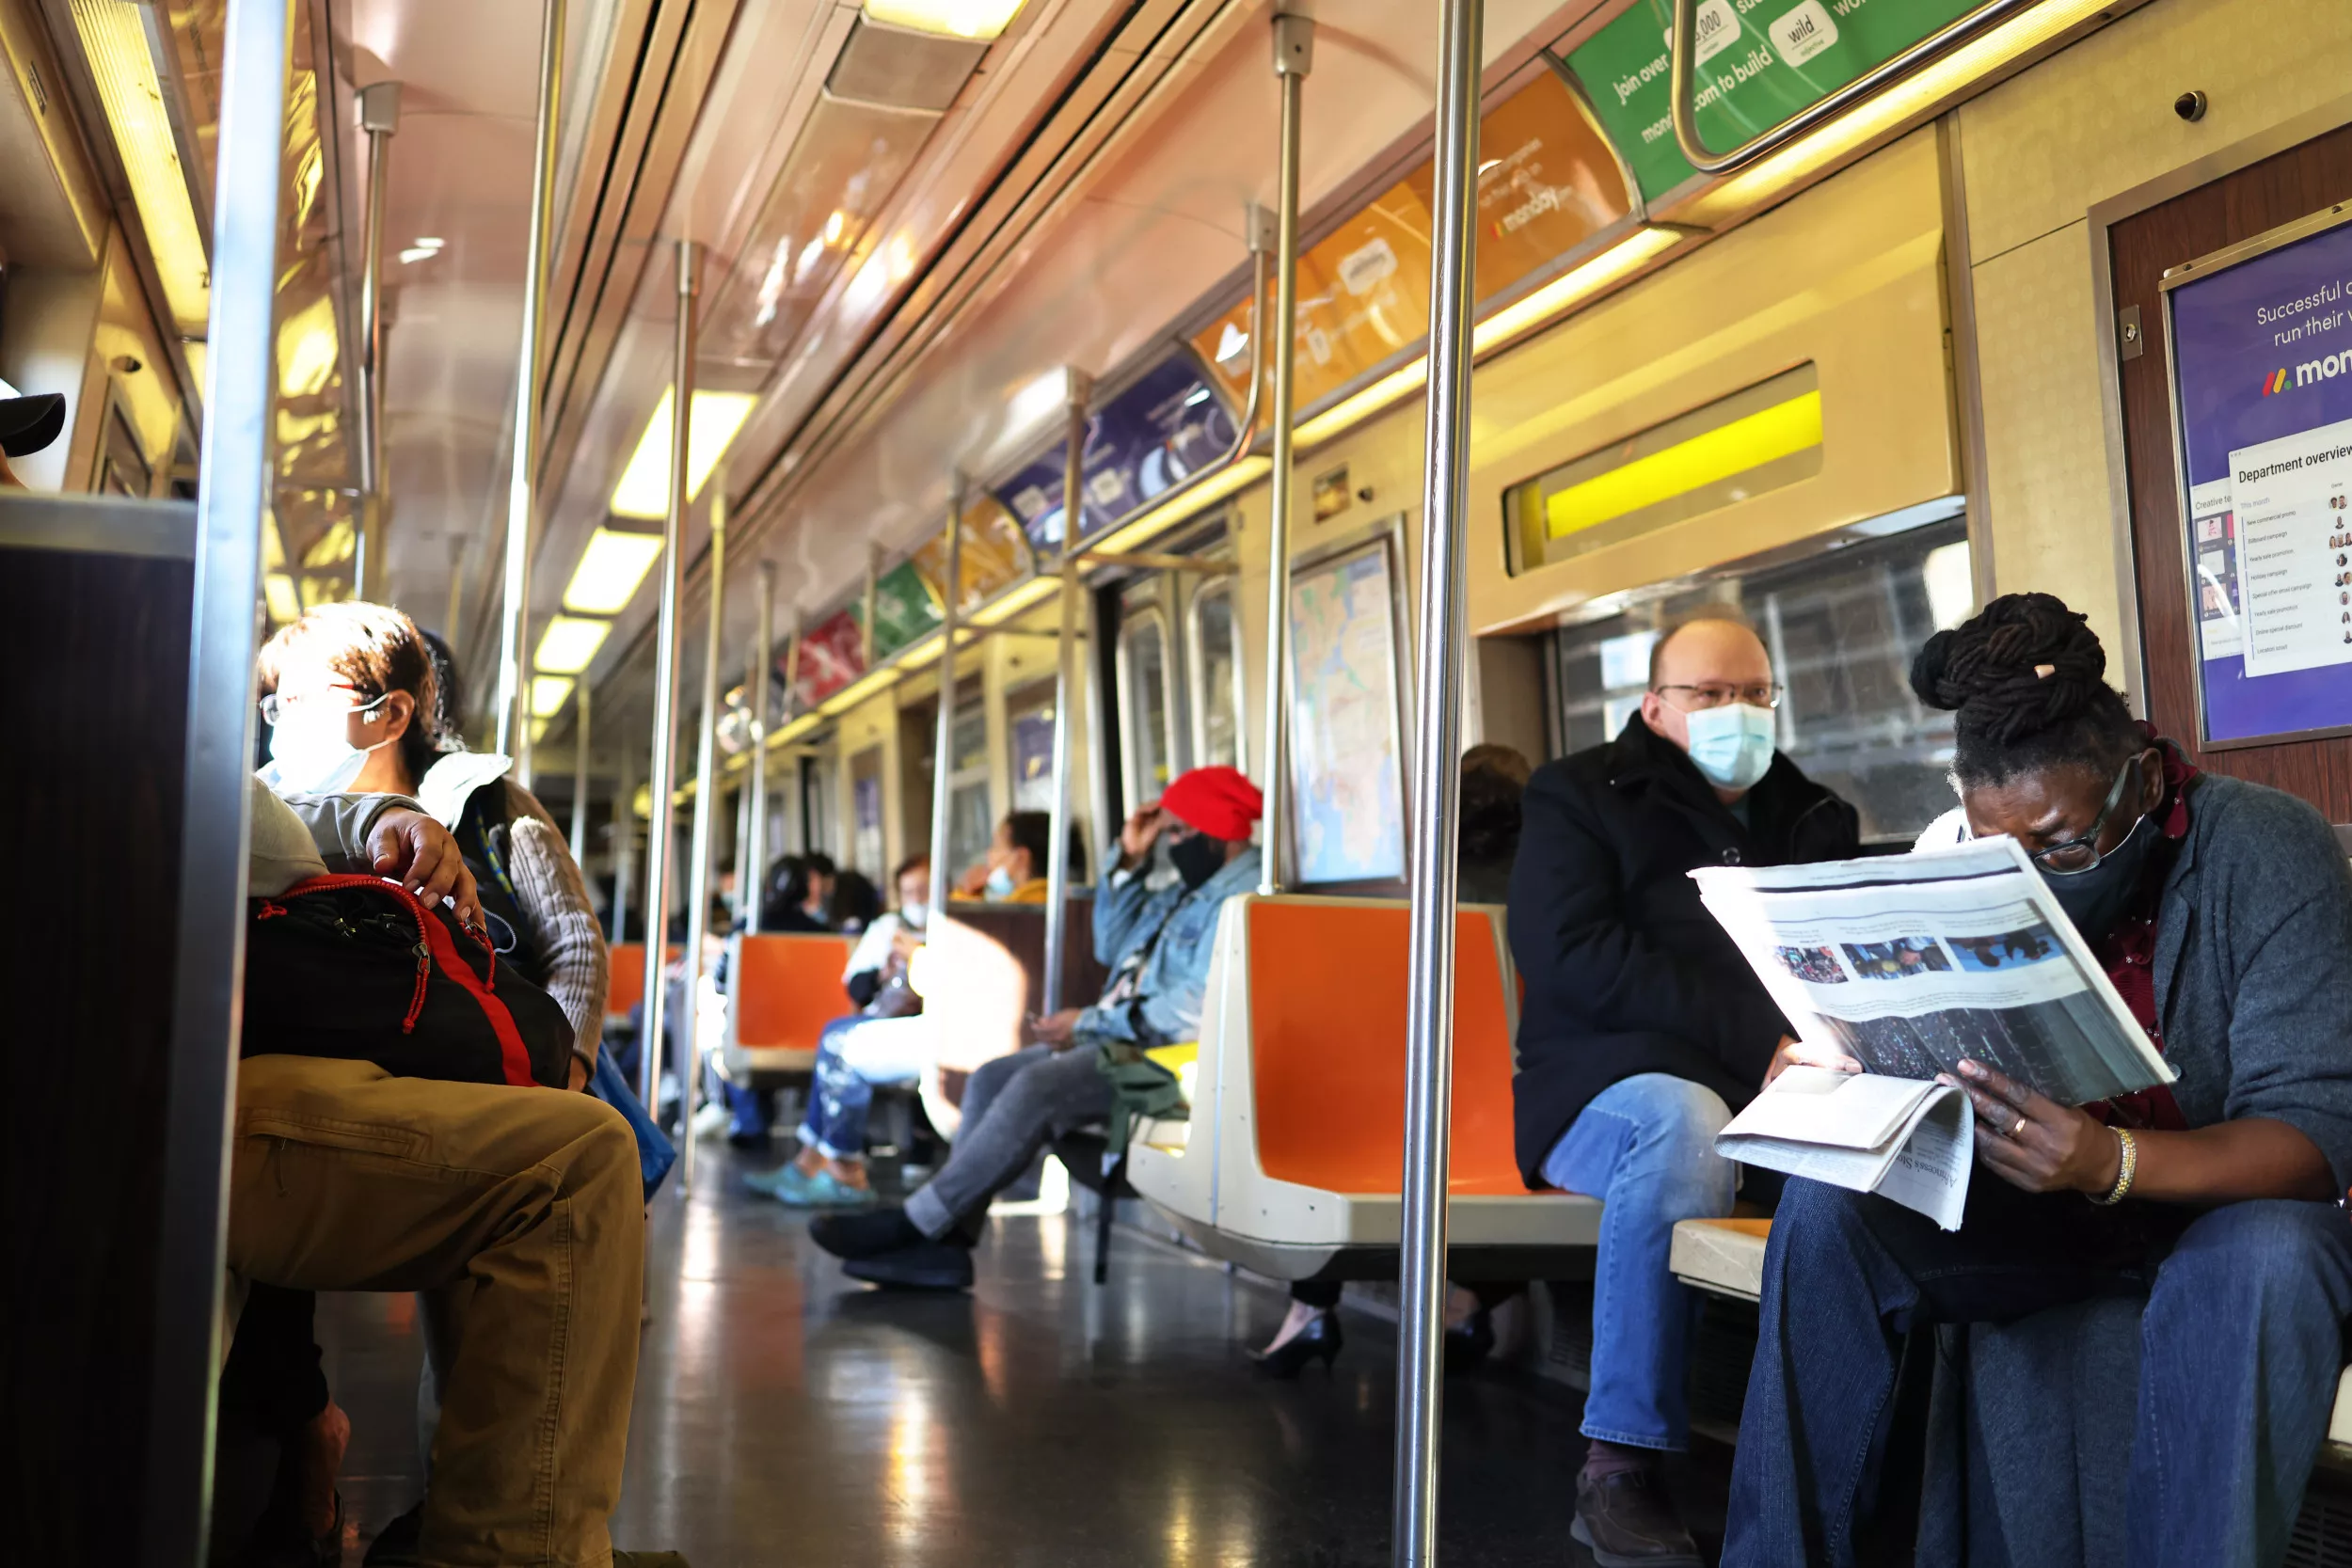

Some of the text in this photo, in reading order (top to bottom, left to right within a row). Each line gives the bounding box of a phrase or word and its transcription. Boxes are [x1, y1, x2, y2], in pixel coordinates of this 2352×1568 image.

[1717, 74, 1736, 93] to
[1731, 43, 1773, 83] build
[1788, 13, 1816, 43] wild
[1832, 0, 1867, 16] wo
[1639, 53, 1670, 83] over
[2257, 280, 2341, 325] Successful
[2274, 326, 2301, 346] run
[2305, 309, 2344, 336] their
[2239, 456, 2303, 483] Department
[2195, 497, 2223, 511] Creative
[2251, 497, 2270, 508] month
[2256, 513, 2281, 524] commercial
[1896, 1154, 1913, 1170] Sto
